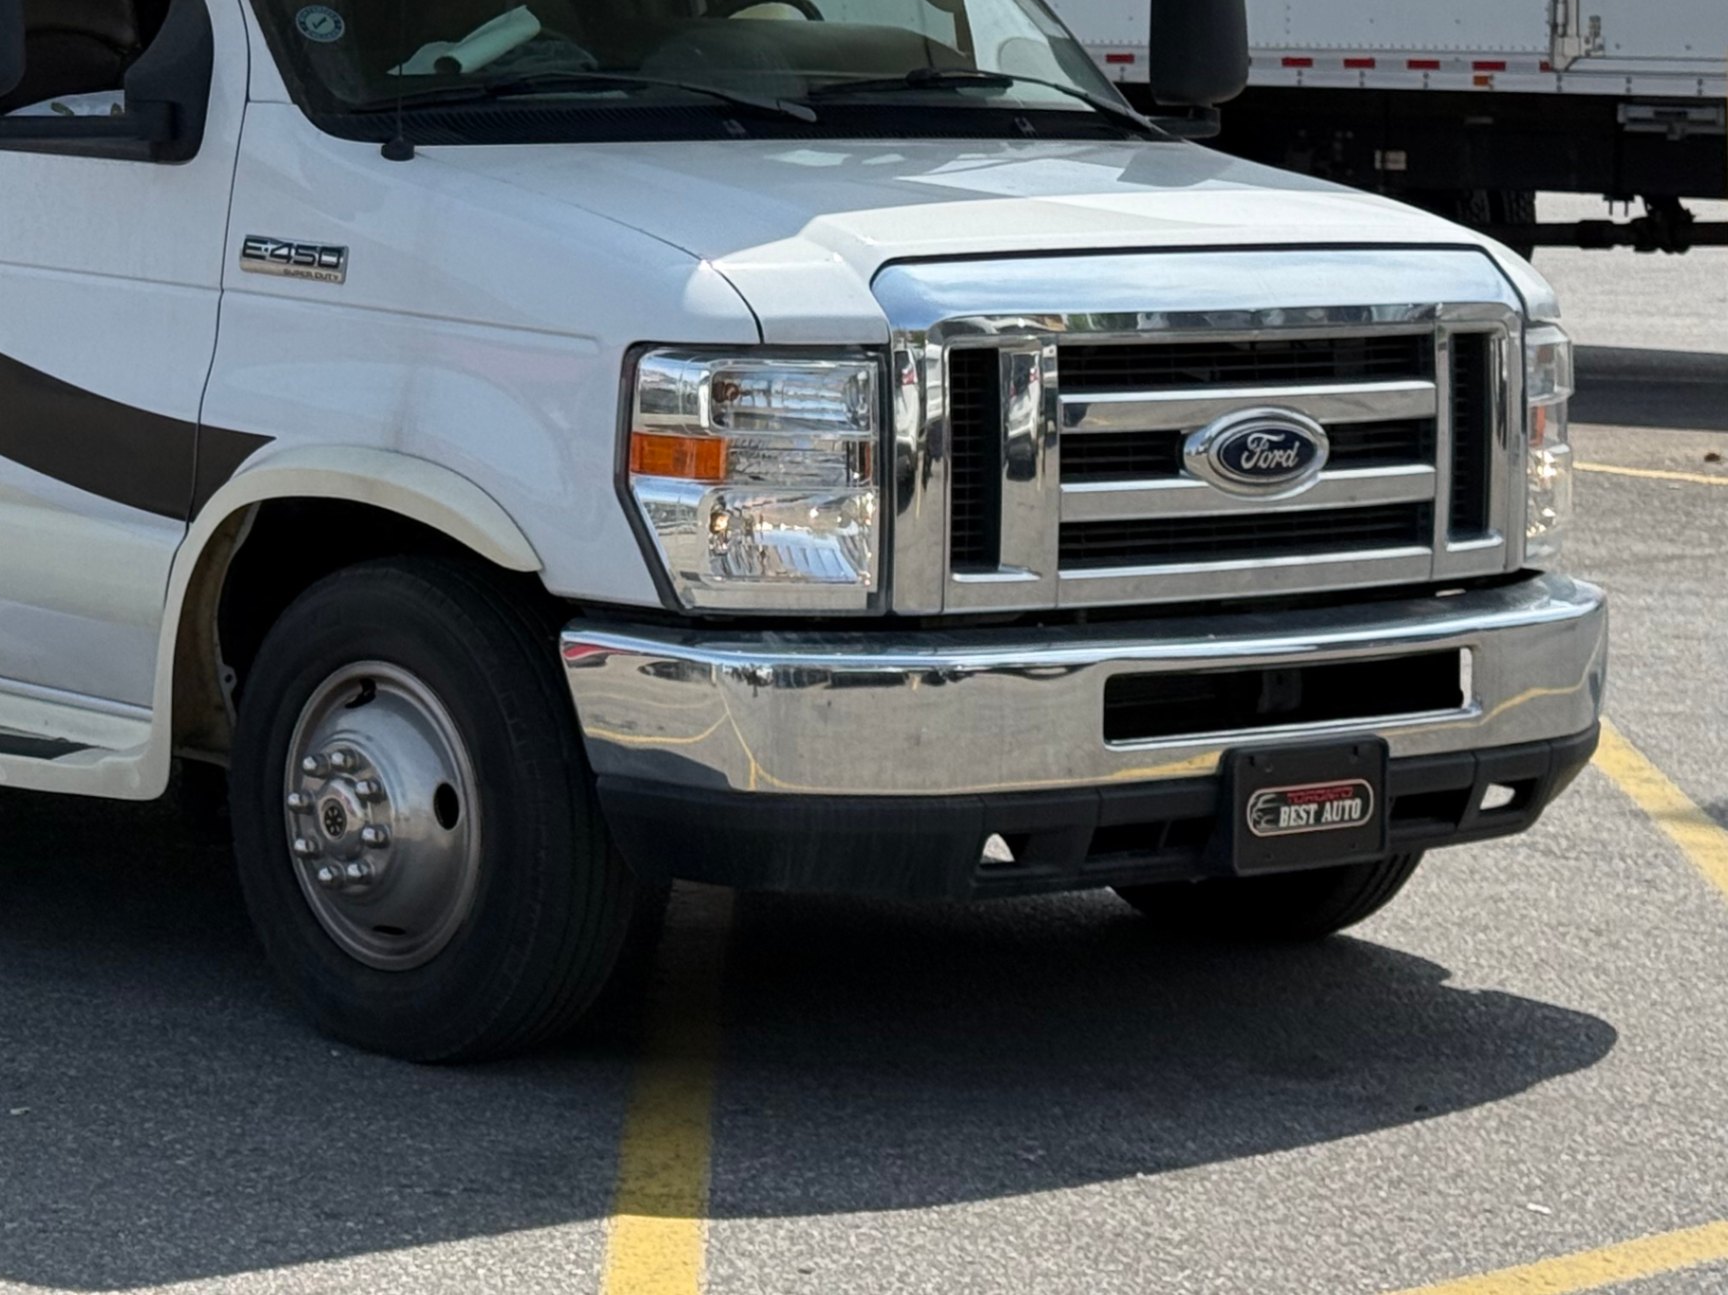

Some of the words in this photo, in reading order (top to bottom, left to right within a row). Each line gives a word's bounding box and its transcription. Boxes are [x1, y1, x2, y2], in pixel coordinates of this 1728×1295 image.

[315, 271, 339, 282] DUTY
[1240, 432, 1300, 470] Ford
[1279, 803, 1318, 827] BEST
[1321, 797, 1362, 823] AUTO
